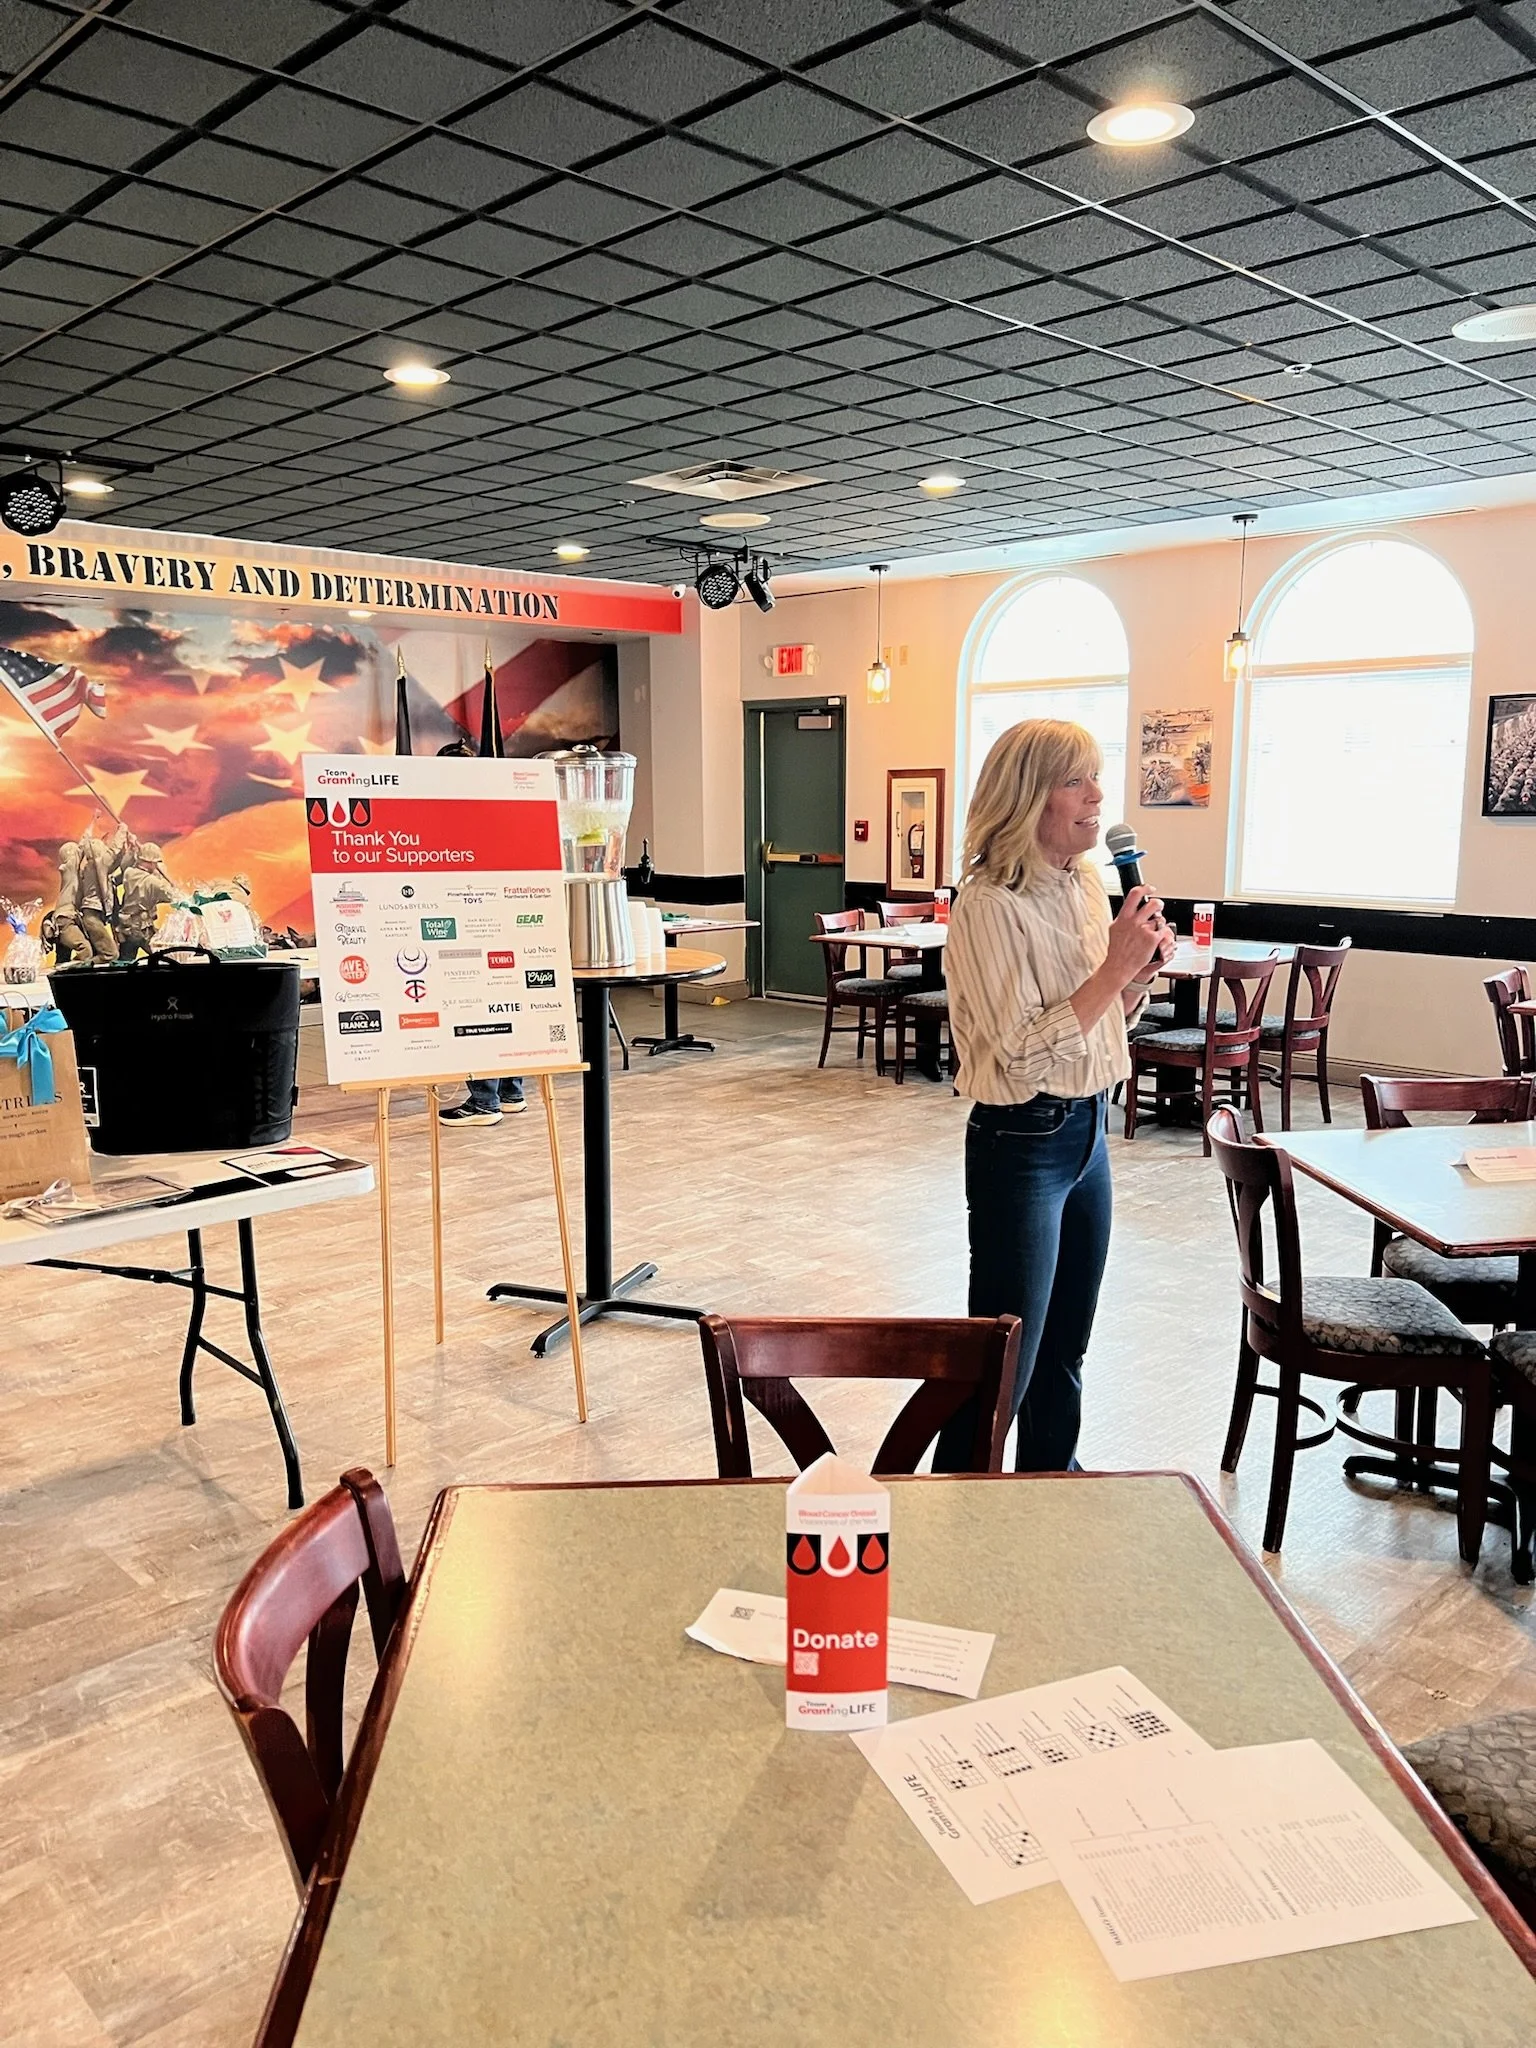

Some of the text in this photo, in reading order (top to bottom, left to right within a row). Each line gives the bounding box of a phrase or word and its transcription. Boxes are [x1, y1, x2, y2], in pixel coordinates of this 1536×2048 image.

[27, 544, 216, 591] BRAVERY
[229, 565, 300, 598] AND
[311, 572, 559, 620] DETERMINATION
[780, 647, 802, 673] EXIT
[331, 830, 420, 846] Thank You
[332, 847, 475, 866] to our Supporters
[516, 915, 544, 924] GEAR
[490, 956, 513, 964] TORO
[488, 1003, 521, 1013] KATIE
[151, 1014, 173, 1022] Hydro
[340, 1020, 369, 1030] FRANCE
[793, 1628, 879, 1649] Donate
